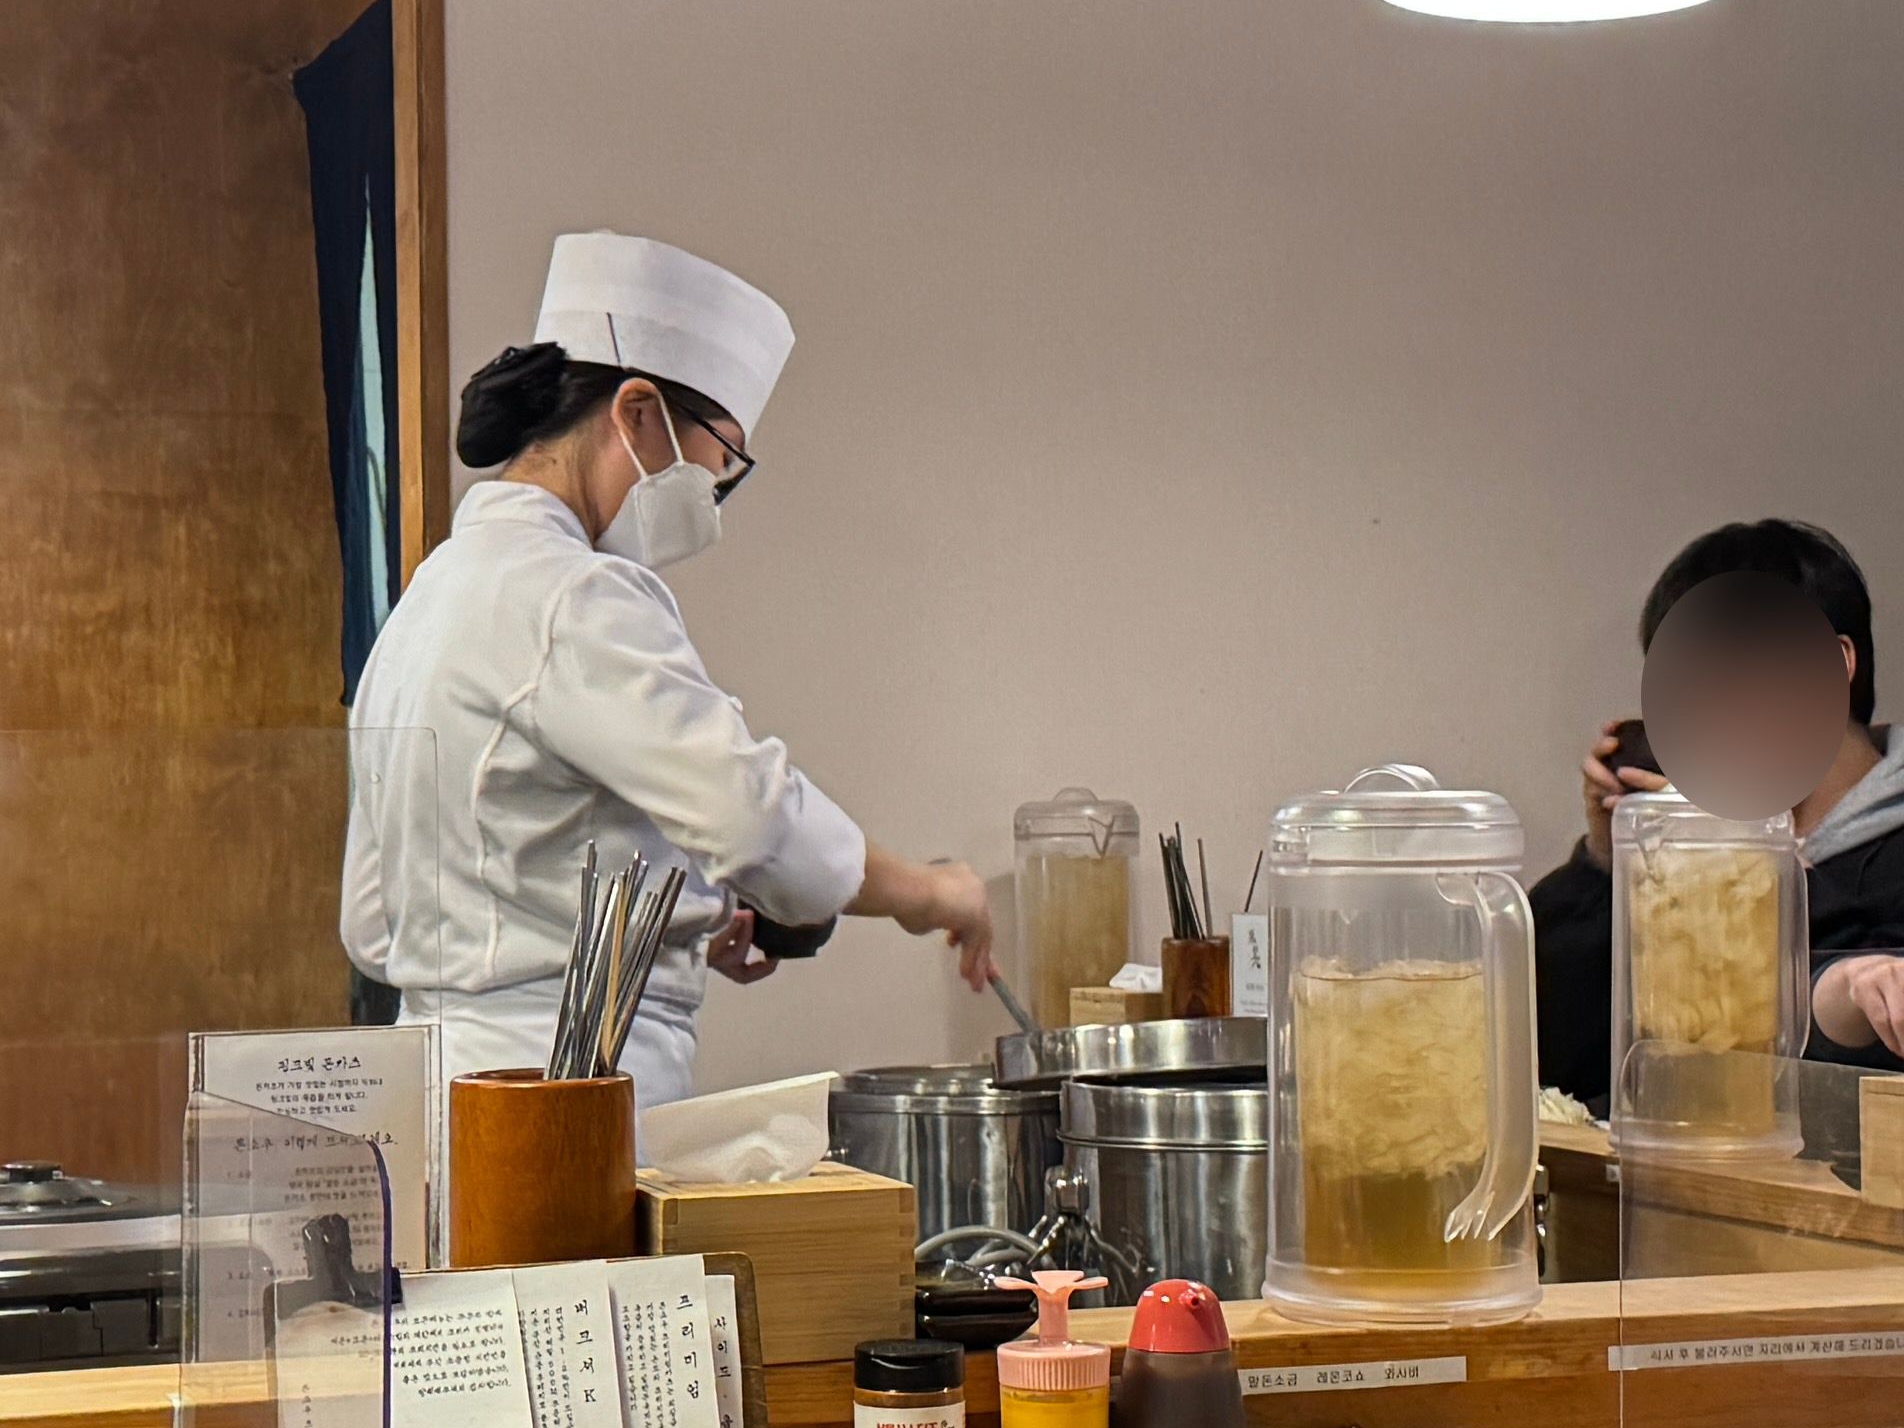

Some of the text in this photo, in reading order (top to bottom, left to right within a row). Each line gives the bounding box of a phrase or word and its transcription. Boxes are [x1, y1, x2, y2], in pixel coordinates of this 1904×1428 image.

[677, 1294, 700, 1400] 프리미엄
[1247, 1372, 1298, 1389] 말돈소금
[1384, 1364, 1419, 1380] 와사비
